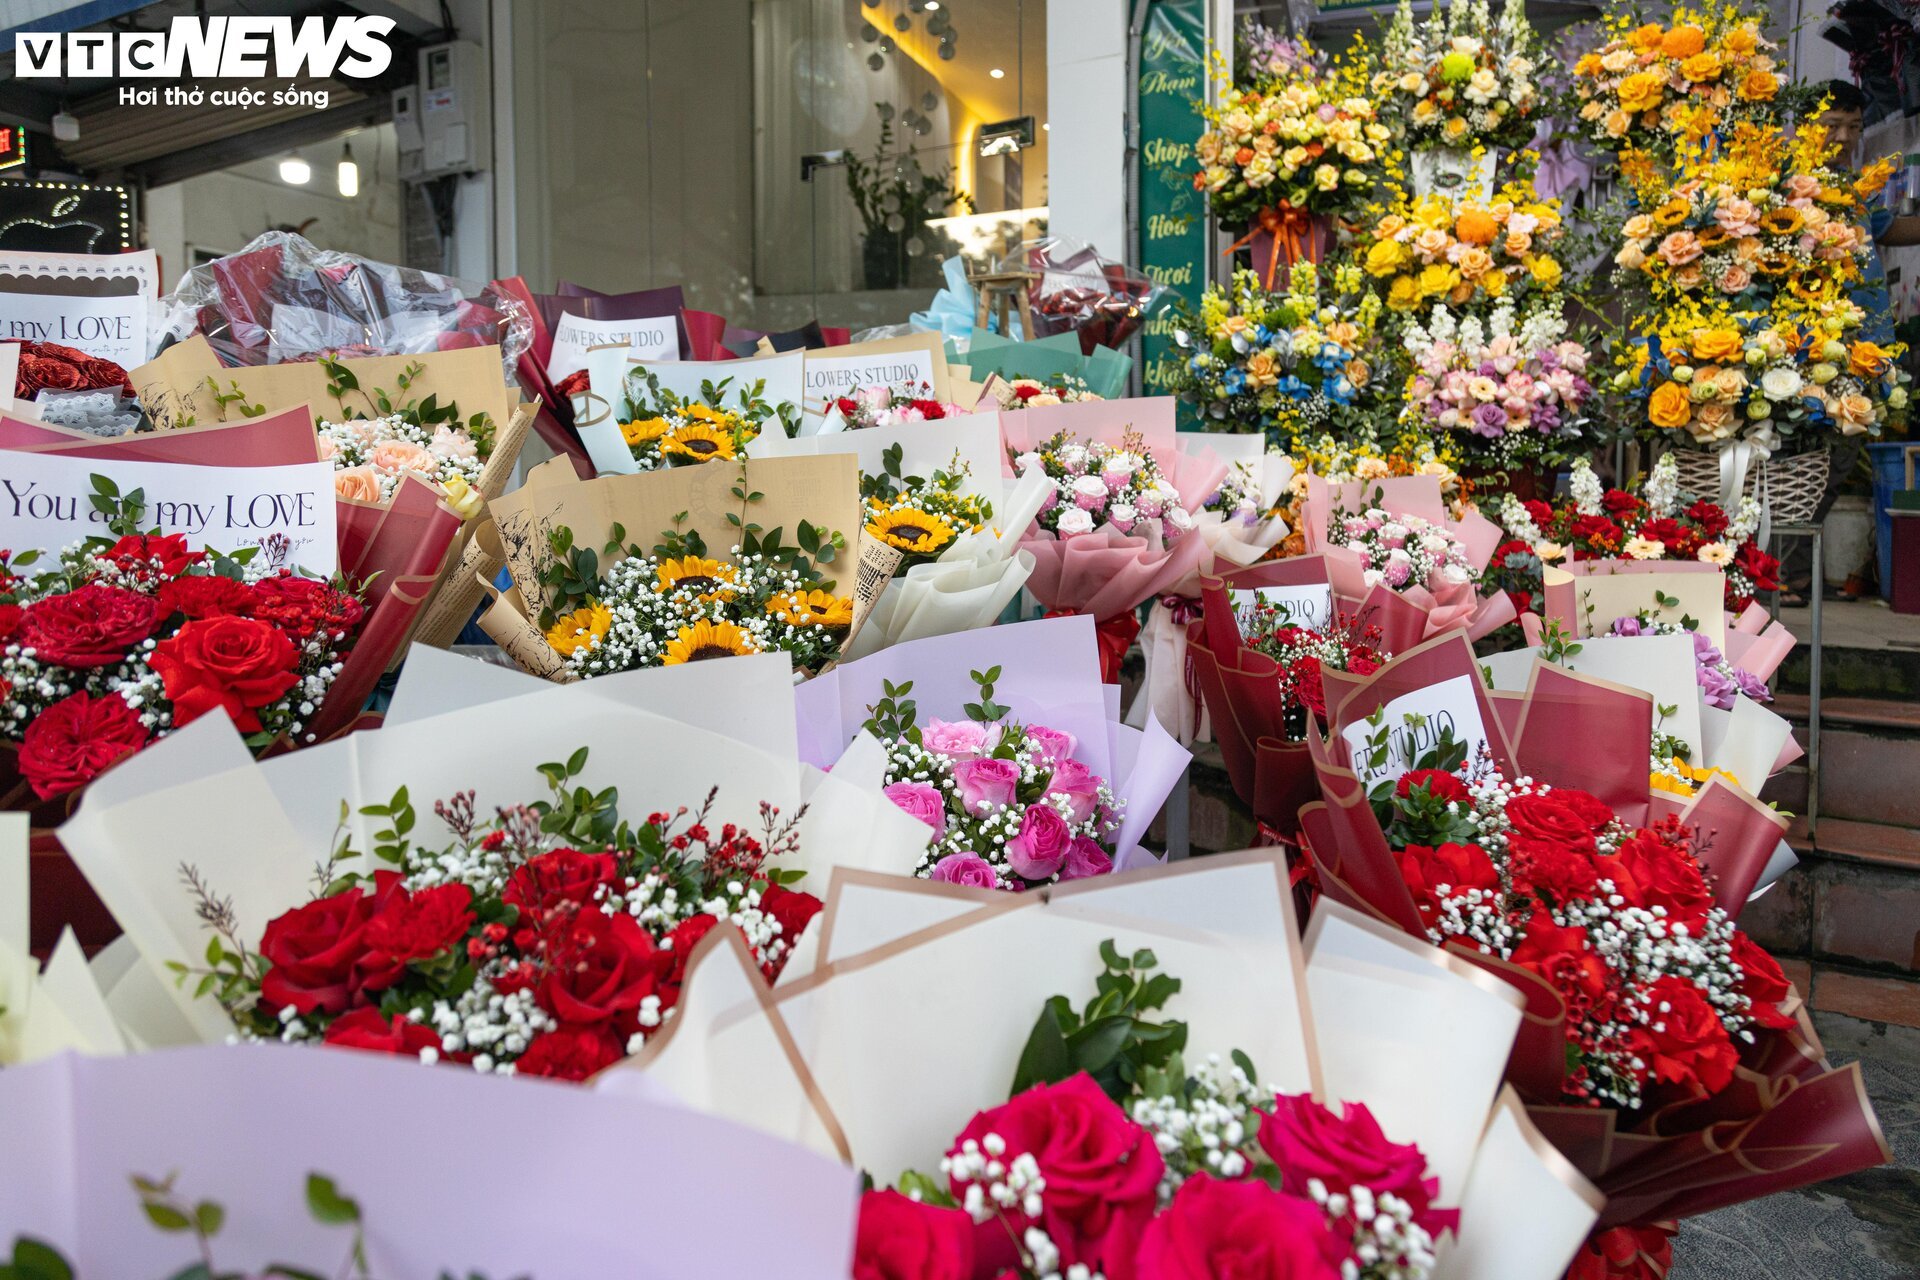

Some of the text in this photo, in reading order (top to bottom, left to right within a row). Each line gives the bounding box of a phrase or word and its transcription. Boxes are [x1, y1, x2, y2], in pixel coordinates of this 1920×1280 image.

[1144, 138, 1190, 168] Shop
[1147, 214, 1188, 240] Hoa
[10, 316, 131, 344] my LOVE
[806, 364, 919, 388] LOWERS STUDIO
[2, 479, 77, 521] You
[156, 502, 215, 535] my
[225, 492, 316, 529] LOVE
